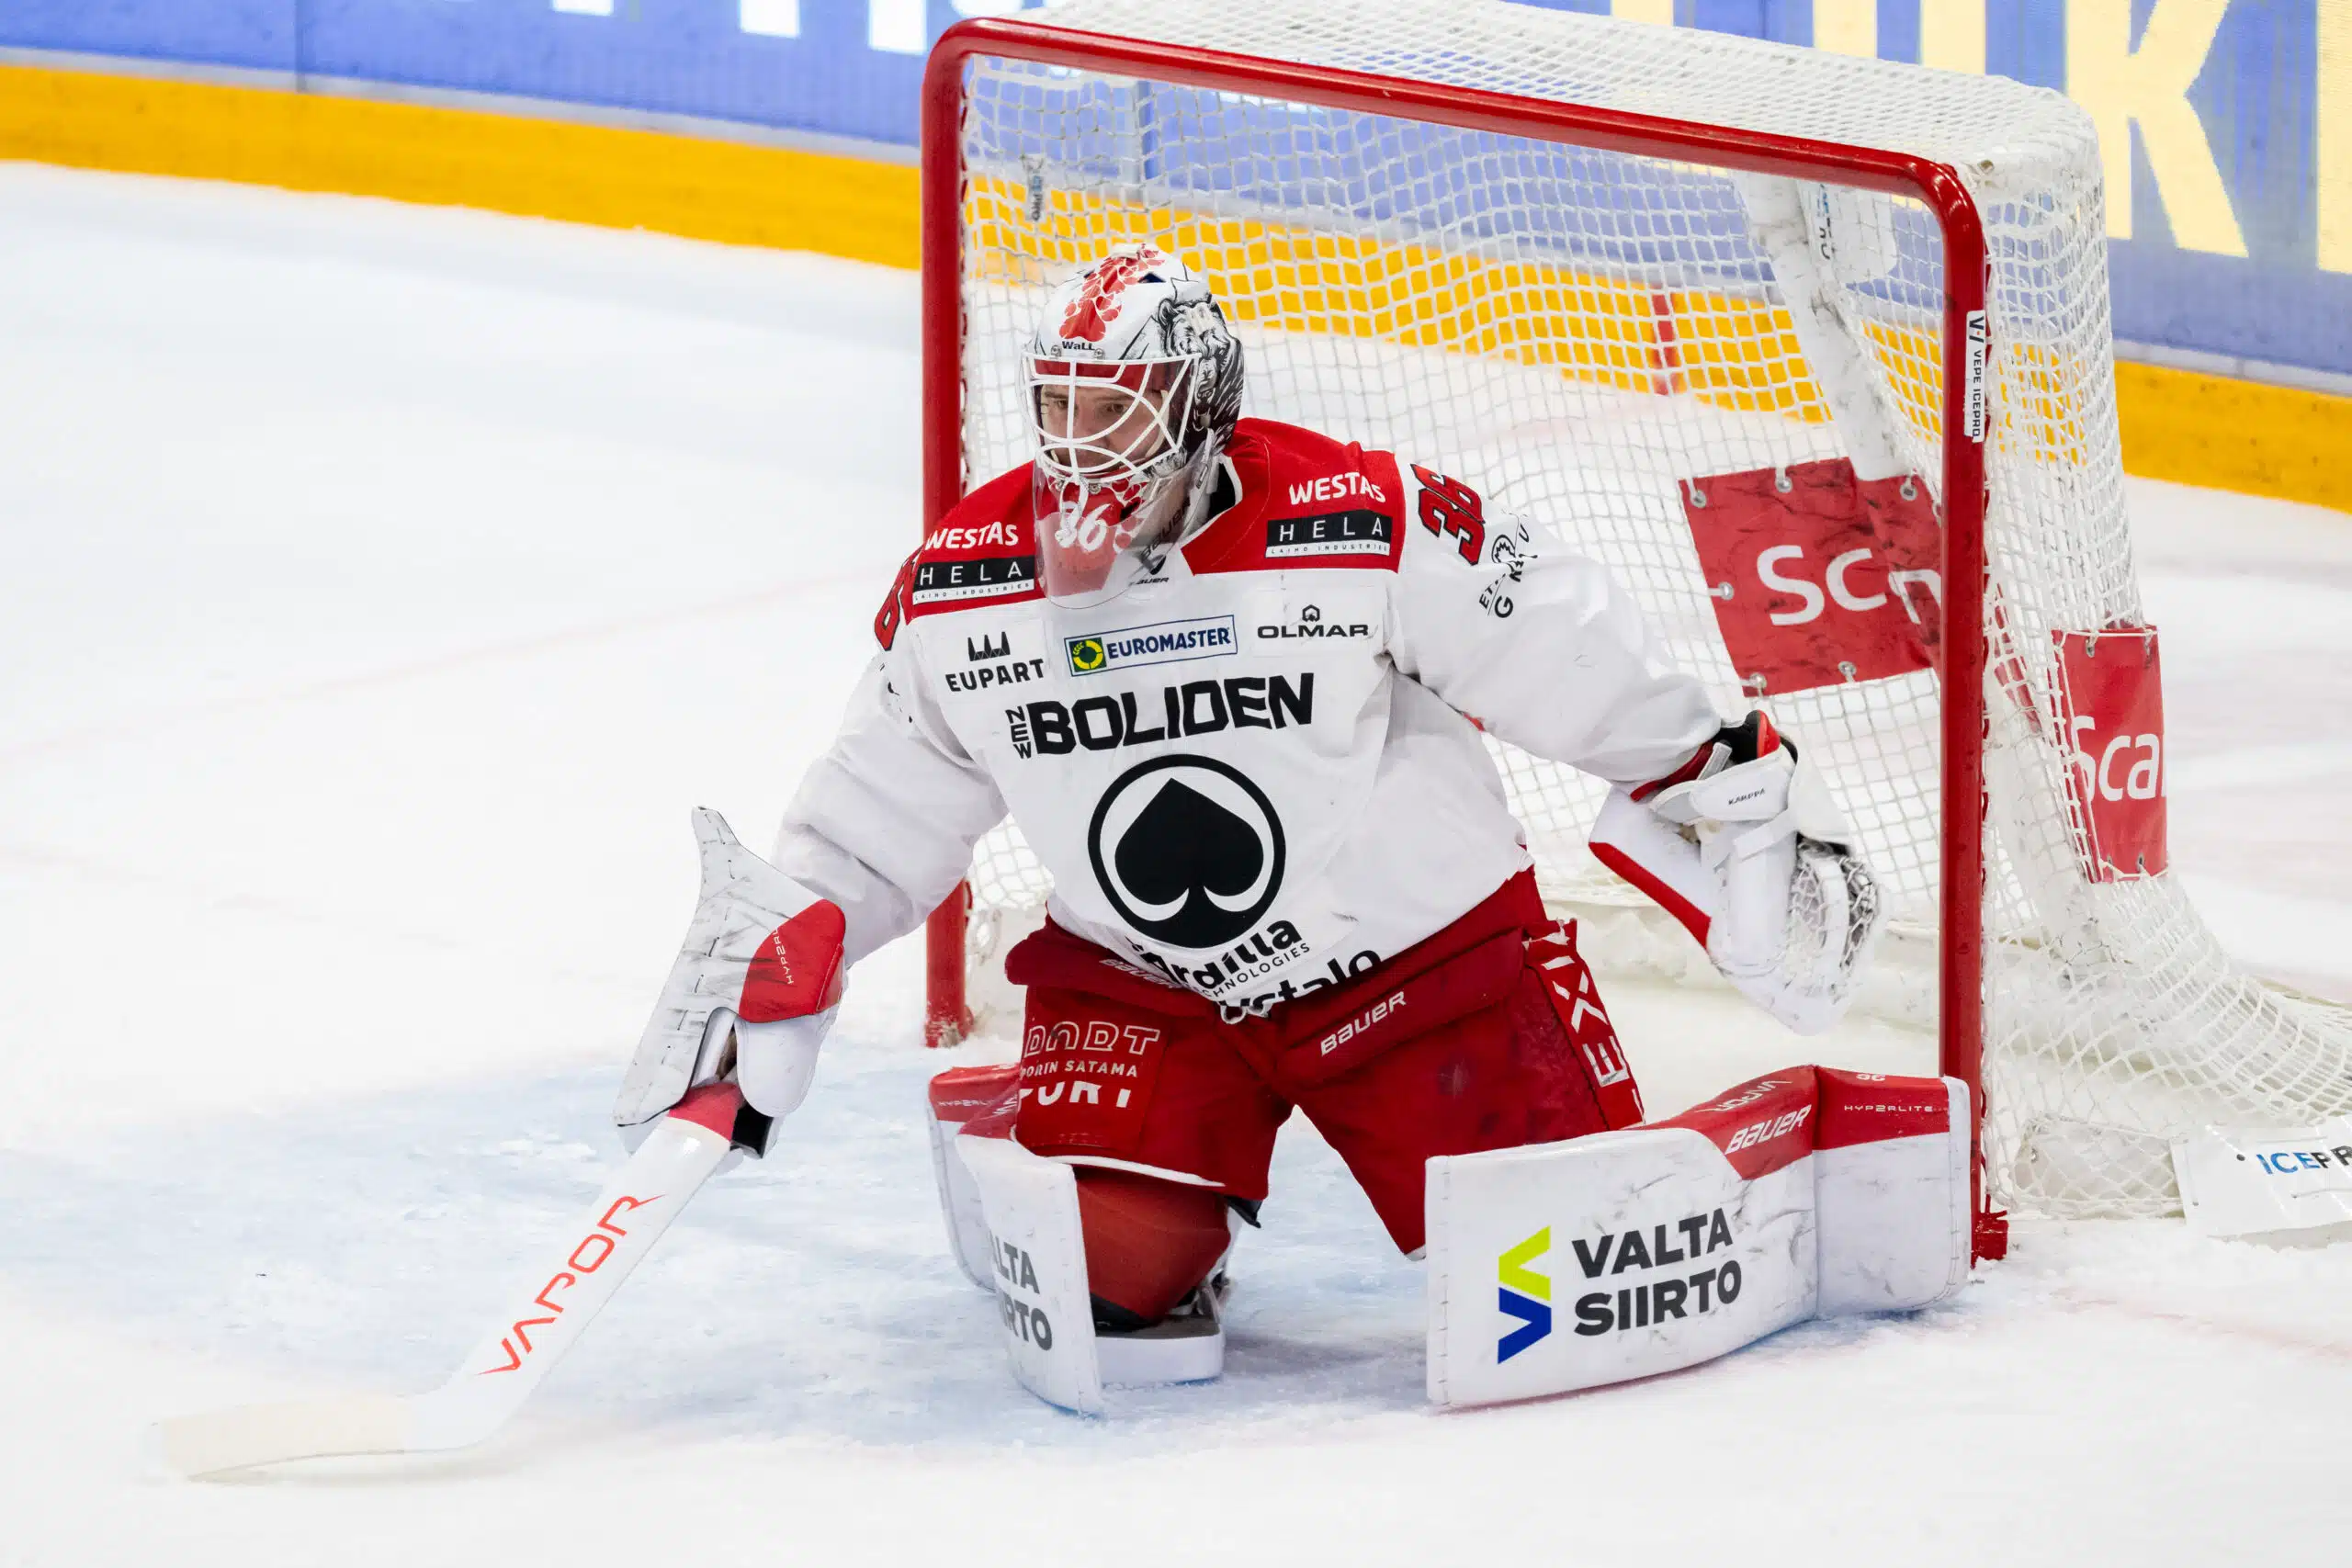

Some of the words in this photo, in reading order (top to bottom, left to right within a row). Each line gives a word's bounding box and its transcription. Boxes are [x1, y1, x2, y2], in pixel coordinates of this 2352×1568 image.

[1973, 349, 1982, 384] VEPE
[1289, 472, 1386, 505] WESTAS
[1279, 517, 1384, 542] HELA
[1409, 463, 1486, 566] 36
[924, 521, 1019, 550] WESTAS
[920, 561, 1023, 586] HELA
[1129, 575, 1169, 585] AUER
[1107, 627, 1231, 660] EUROMASTER
[1257, 624, 1369, 639] OLMAR
[945, 659, 1045, 693] EUPART
[1005, 705, 1032, 759] NEW
[1026, 672, 1314, 755] BOLIDEN
[2070, 716, 2166, 802] Sca
[1320, 991, 1407, 1056] BAUER
[1064, 1060, 1139, 1078] SATAMA
[1724, 1104, 1812, 1156] BAUER
[1571, 1207, 1734, 1279] VALTA
[989, 1230, 1040, 1295] LTA
[474, 1194, 667, 1376] VAPOR
[1574, 1259, 1742, 1337] SIIRTO
